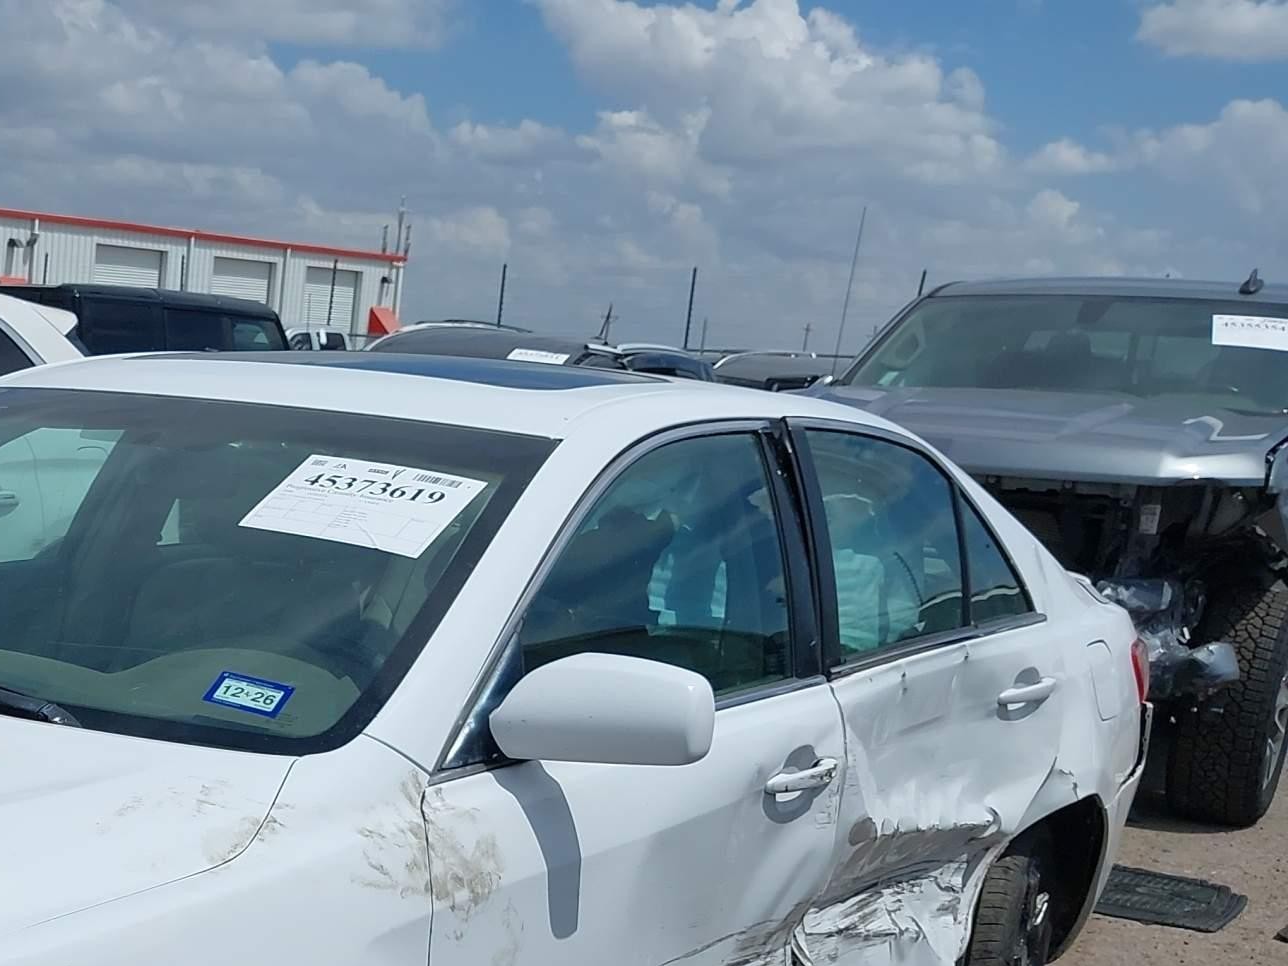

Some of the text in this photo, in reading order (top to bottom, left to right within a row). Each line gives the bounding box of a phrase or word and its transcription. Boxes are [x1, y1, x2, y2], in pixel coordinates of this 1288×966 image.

[304, 472, 447, 505] 45373619
[222, 685, 245, 699] 12
[250, 691, 277, 706] 26
